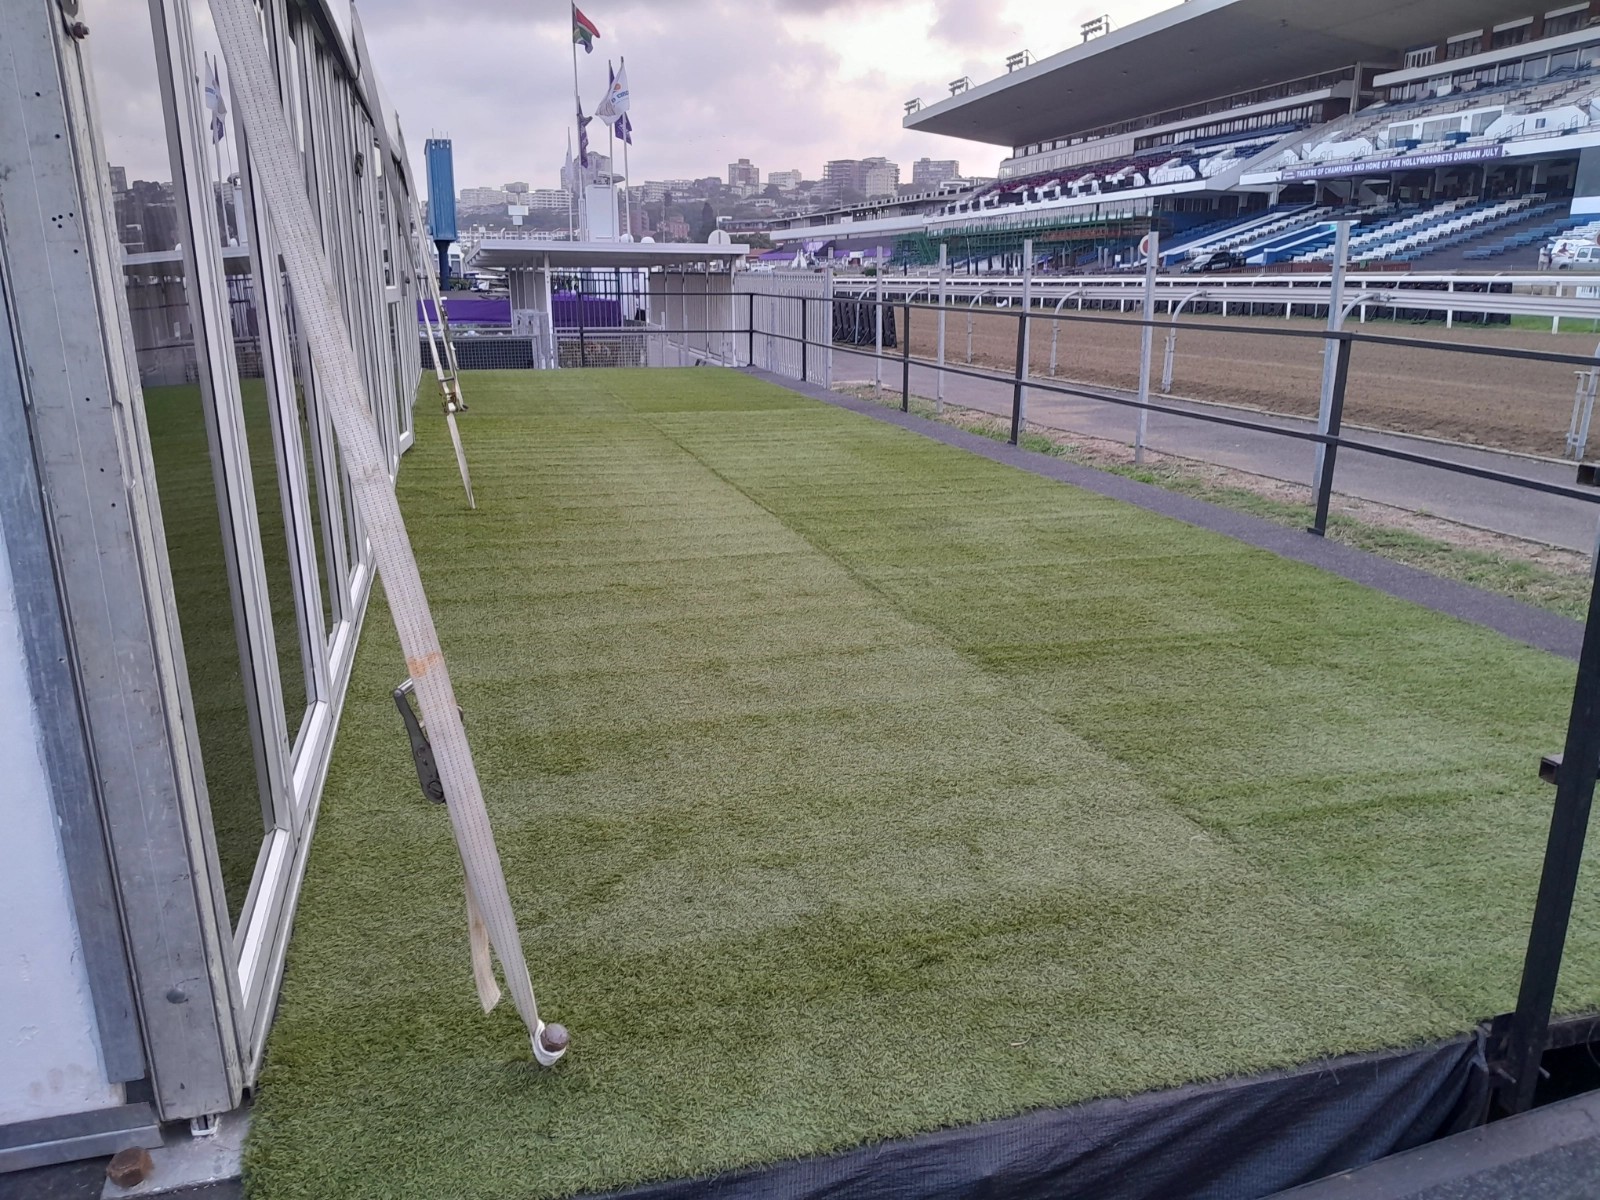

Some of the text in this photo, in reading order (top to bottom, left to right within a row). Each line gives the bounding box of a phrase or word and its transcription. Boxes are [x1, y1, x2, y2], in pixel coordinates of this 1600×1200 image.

[1296, 169, 1316, 178] THEATRE
[1324, 164, 1353, 174] CHAMPIONS
[1354, 163, 1365, 171] AND
[1365, 162, 1380, 170] HOME
[1390, 159, 1400, 168] THE
[1401, 153, 1453, 166] HOLLYWOODBETS
[1453, 149, 1480, 161] DURBAN
[1481, 147, 1499, 158] JULY
